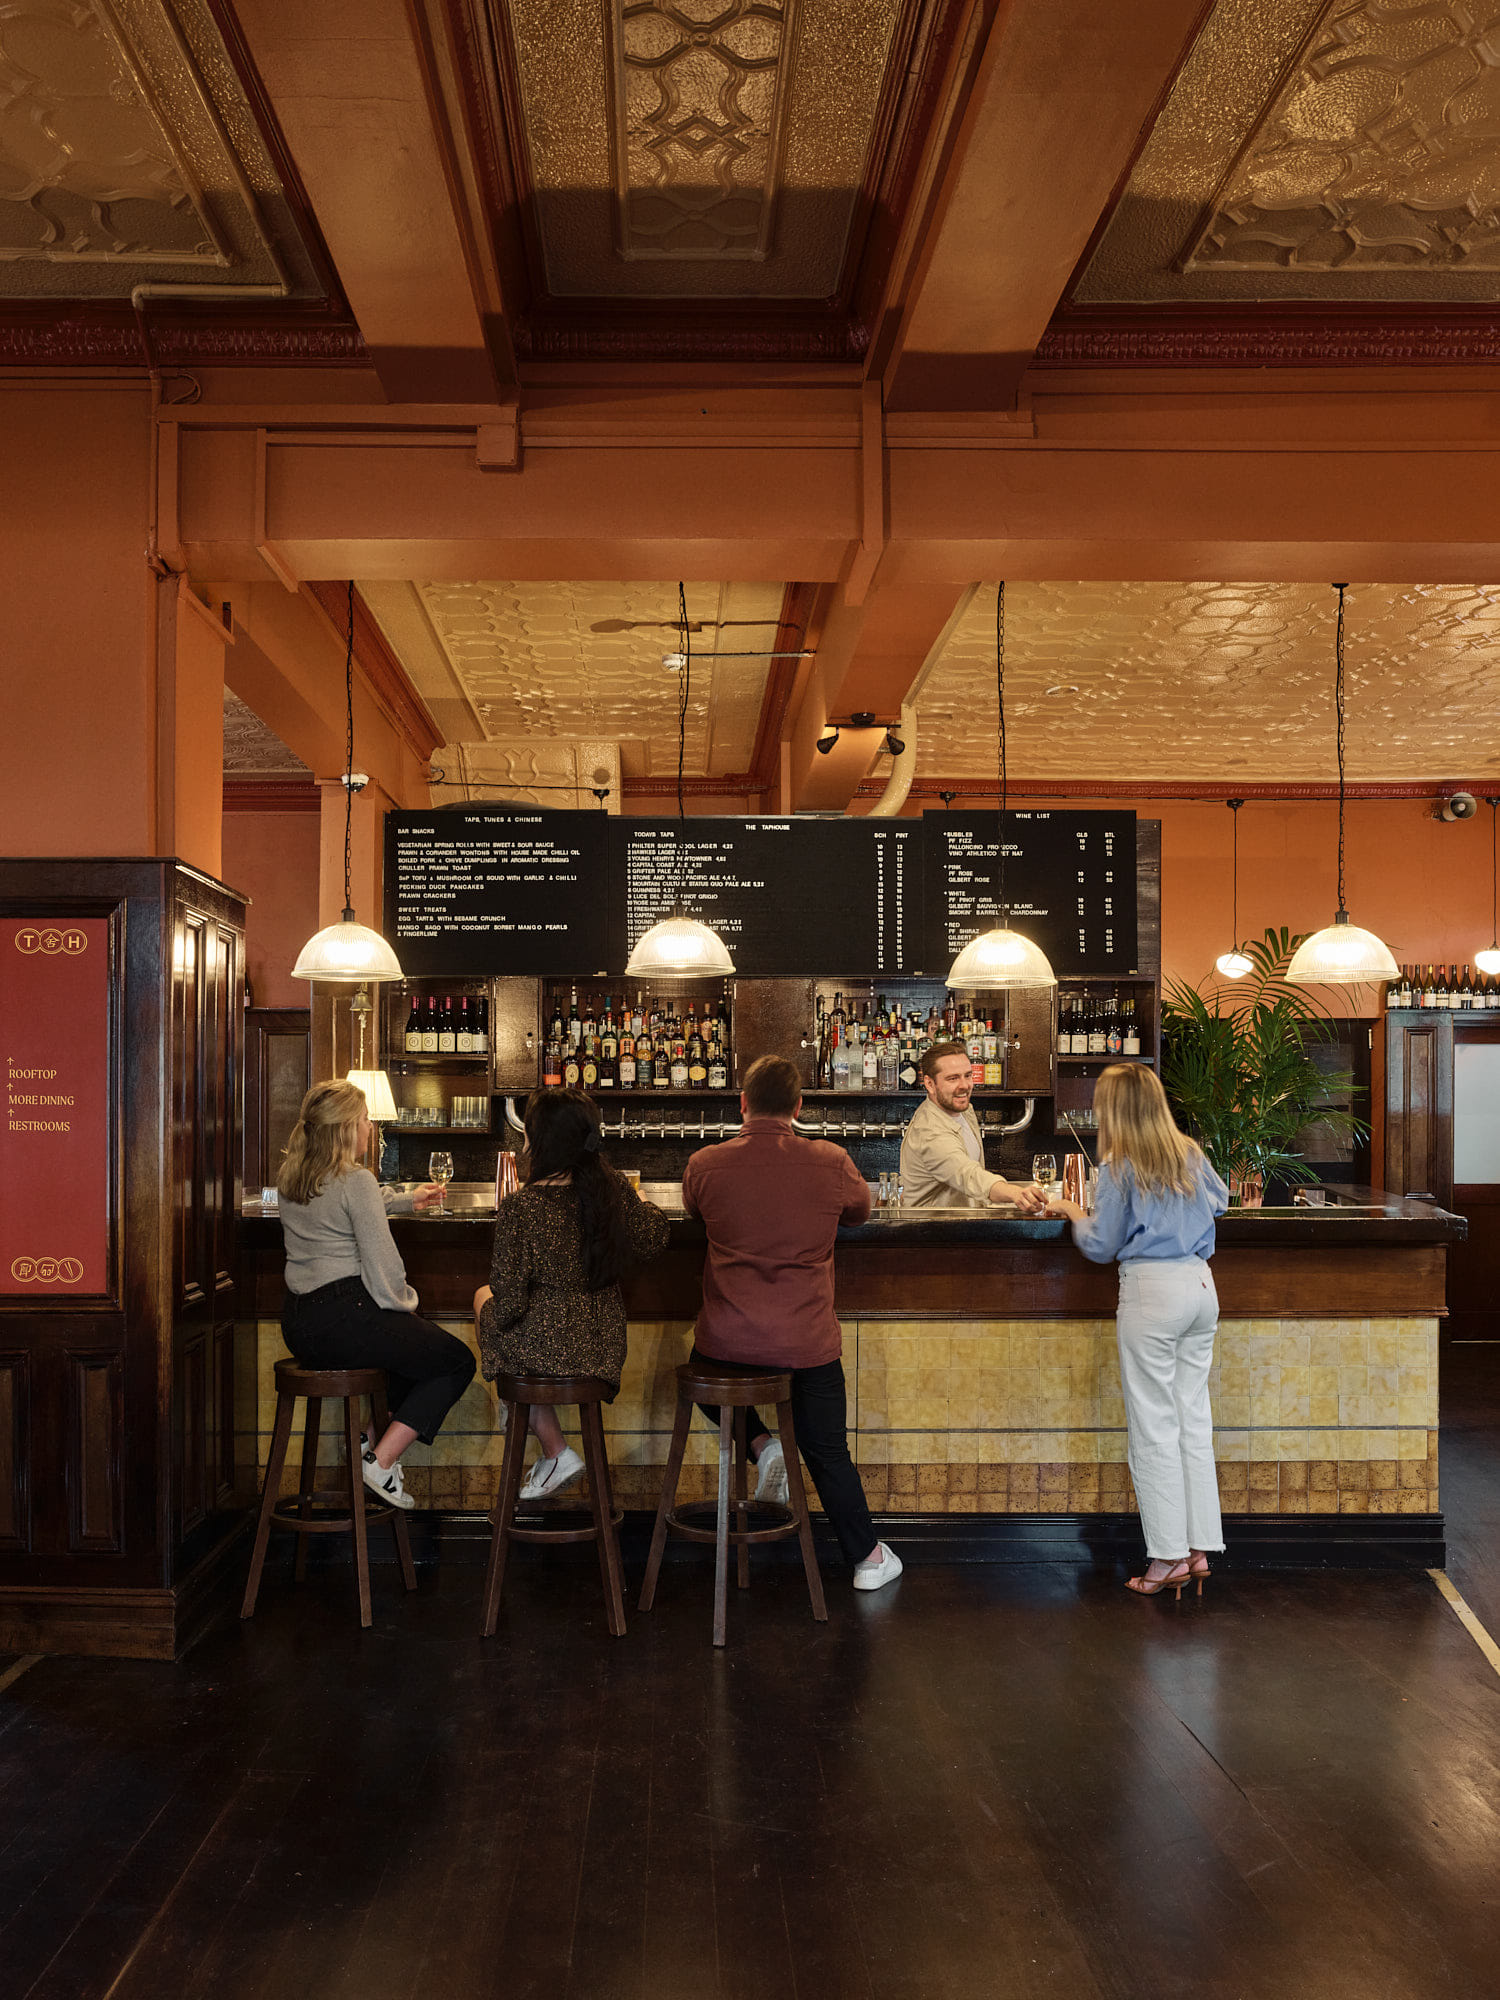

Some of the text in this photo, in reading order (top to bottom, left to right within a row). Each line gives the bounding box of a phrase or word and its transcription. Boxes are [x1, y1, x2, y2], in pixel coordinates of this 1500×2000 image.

[8, 1068, 57, 1080] ROOFTOP
[8, 1094, 75, 1106] MORE DINING
[8, 1120, 71, 1132] RESTROOMS
